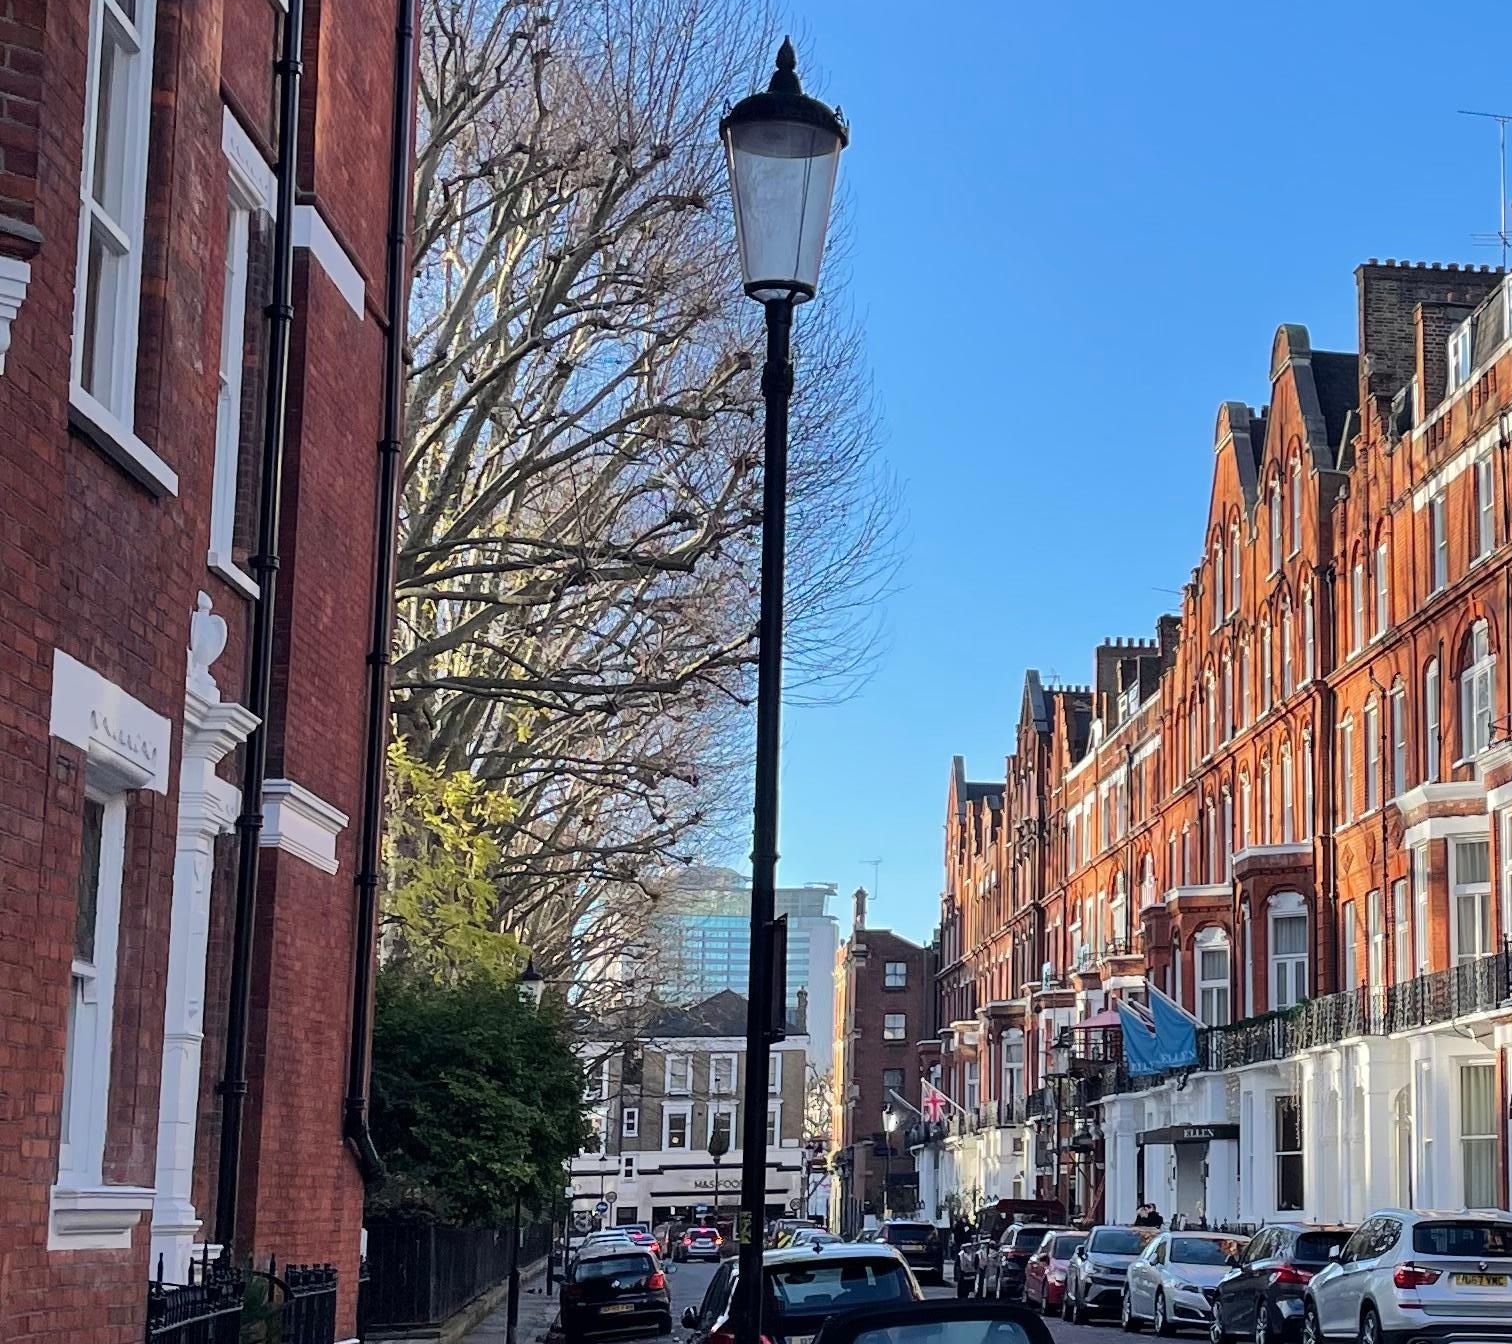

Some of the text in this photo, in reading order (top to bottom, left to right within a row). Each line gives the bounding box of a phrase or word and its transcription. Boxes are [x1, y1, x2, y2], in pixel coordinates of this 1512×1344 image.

[1183, 1128, 1215, 1138] ELLEN
[694, 1179, 743, 1189] M&S FOO
